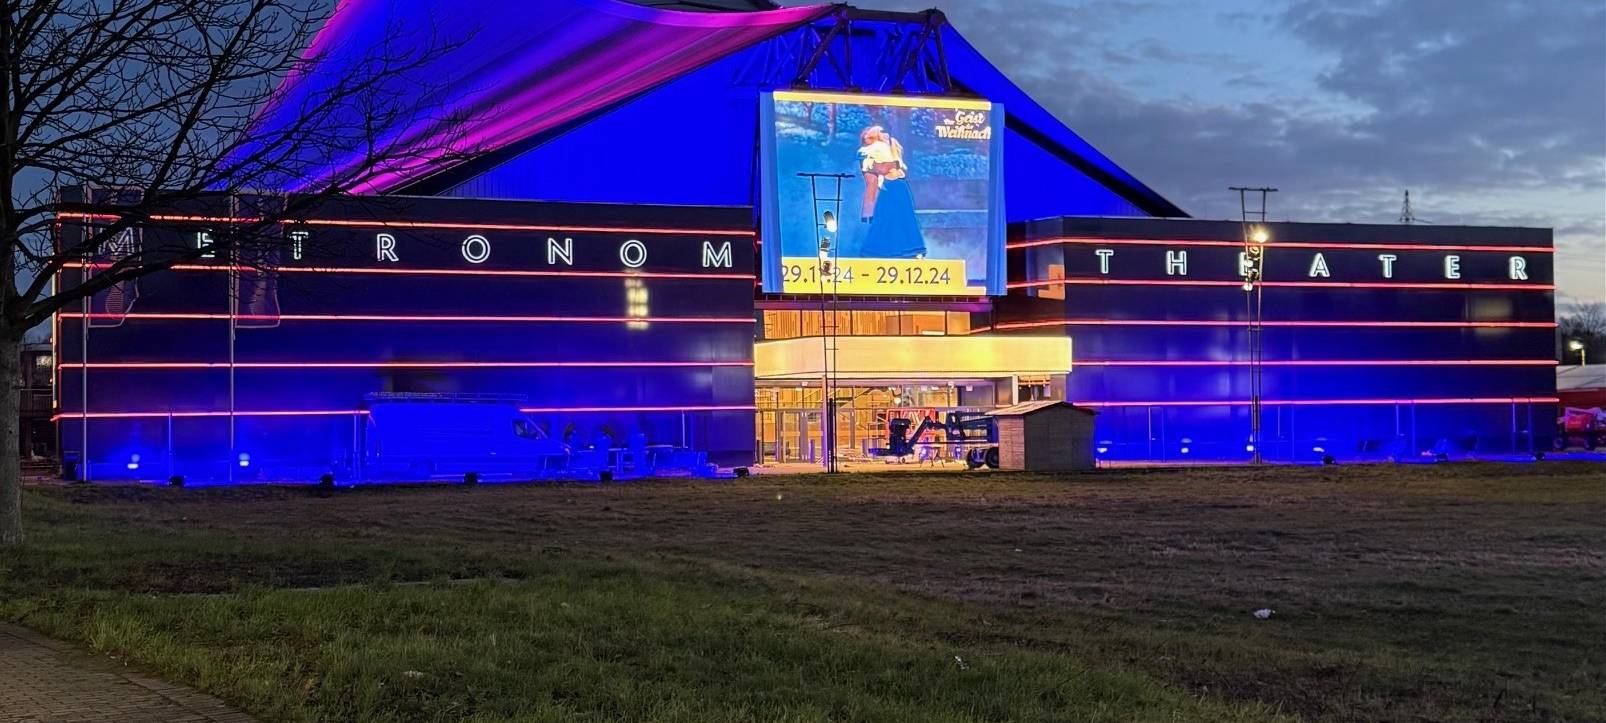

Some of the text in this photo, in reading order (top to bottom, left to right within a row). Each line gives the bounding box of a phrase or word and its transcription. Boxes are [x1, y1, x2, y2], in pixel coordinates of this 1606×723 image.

[954, 110, 985, 126] Geist
[97, 226, 732, 268] METRONOM
[782, 265, 854, 284] 29.1.24
[877, 266, 951, 285] 29.12.24
